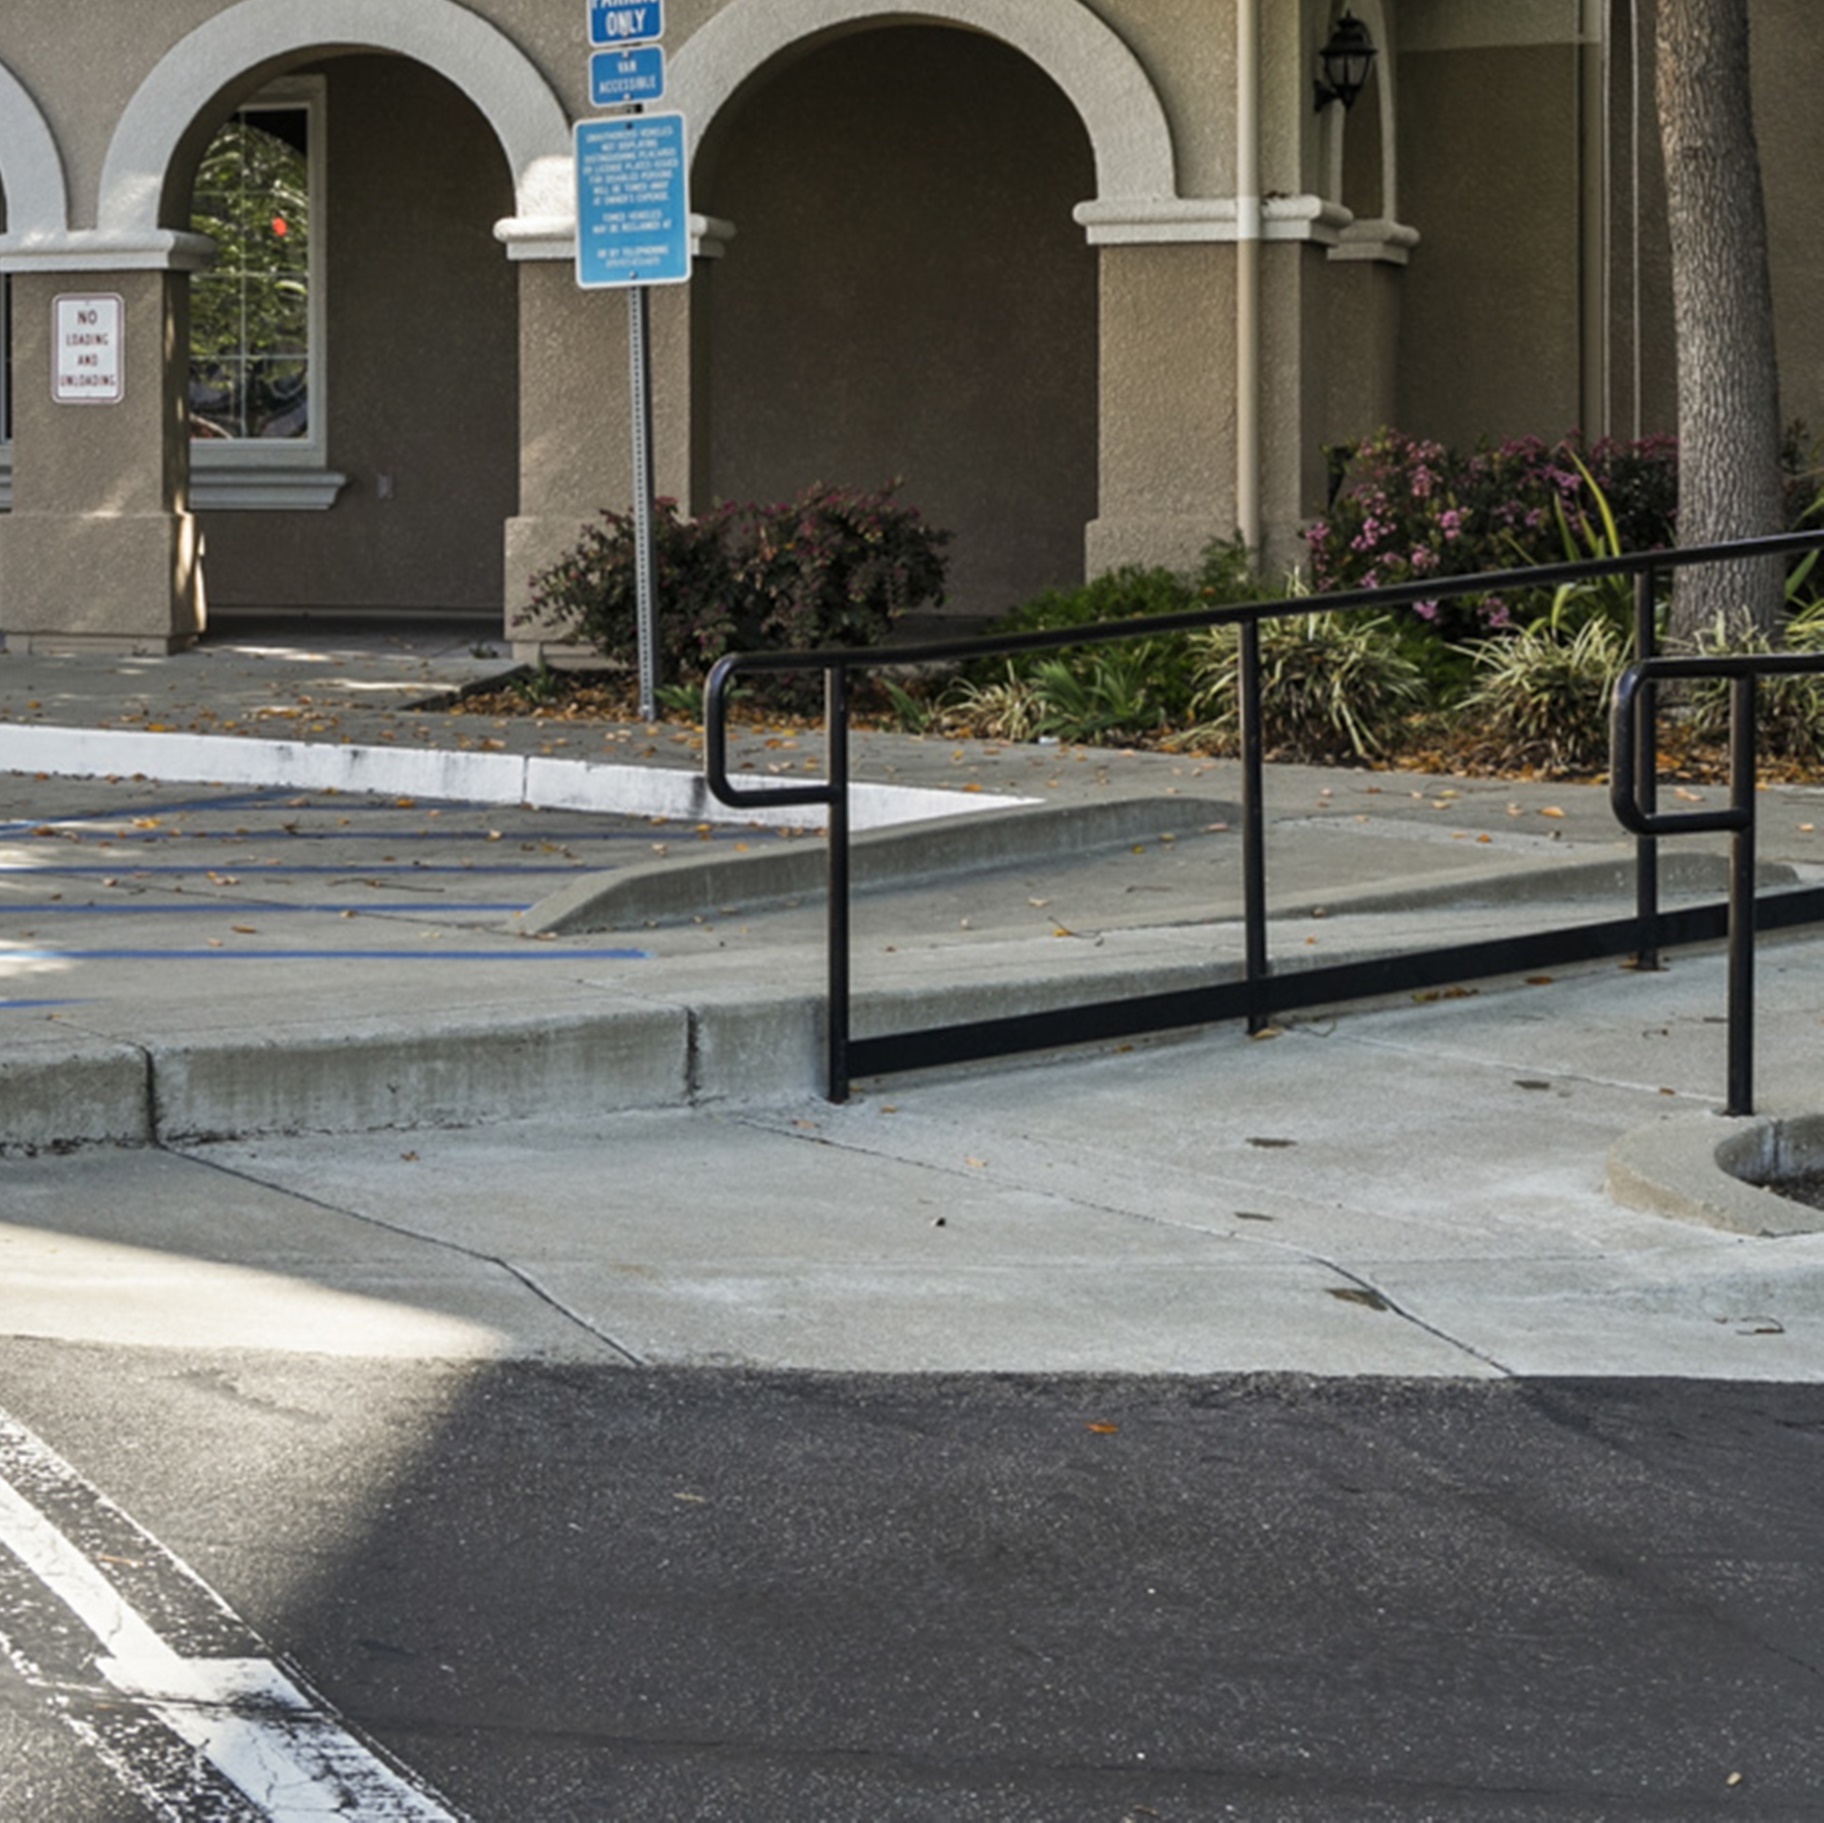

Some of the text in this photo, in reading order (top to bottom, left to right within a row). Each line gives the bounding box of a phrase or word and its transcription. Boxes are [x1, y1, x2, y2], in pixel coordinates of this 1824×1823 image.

[605, 8, 646, 36] ONLY
[617, 59, 637, 74] VAN
[77, 308, 98, 325] NO
[66, 333, 109, 347] LOADING
[78, 354, 98, 367] AND
[60, 374, 116, 388] UNLOADING
